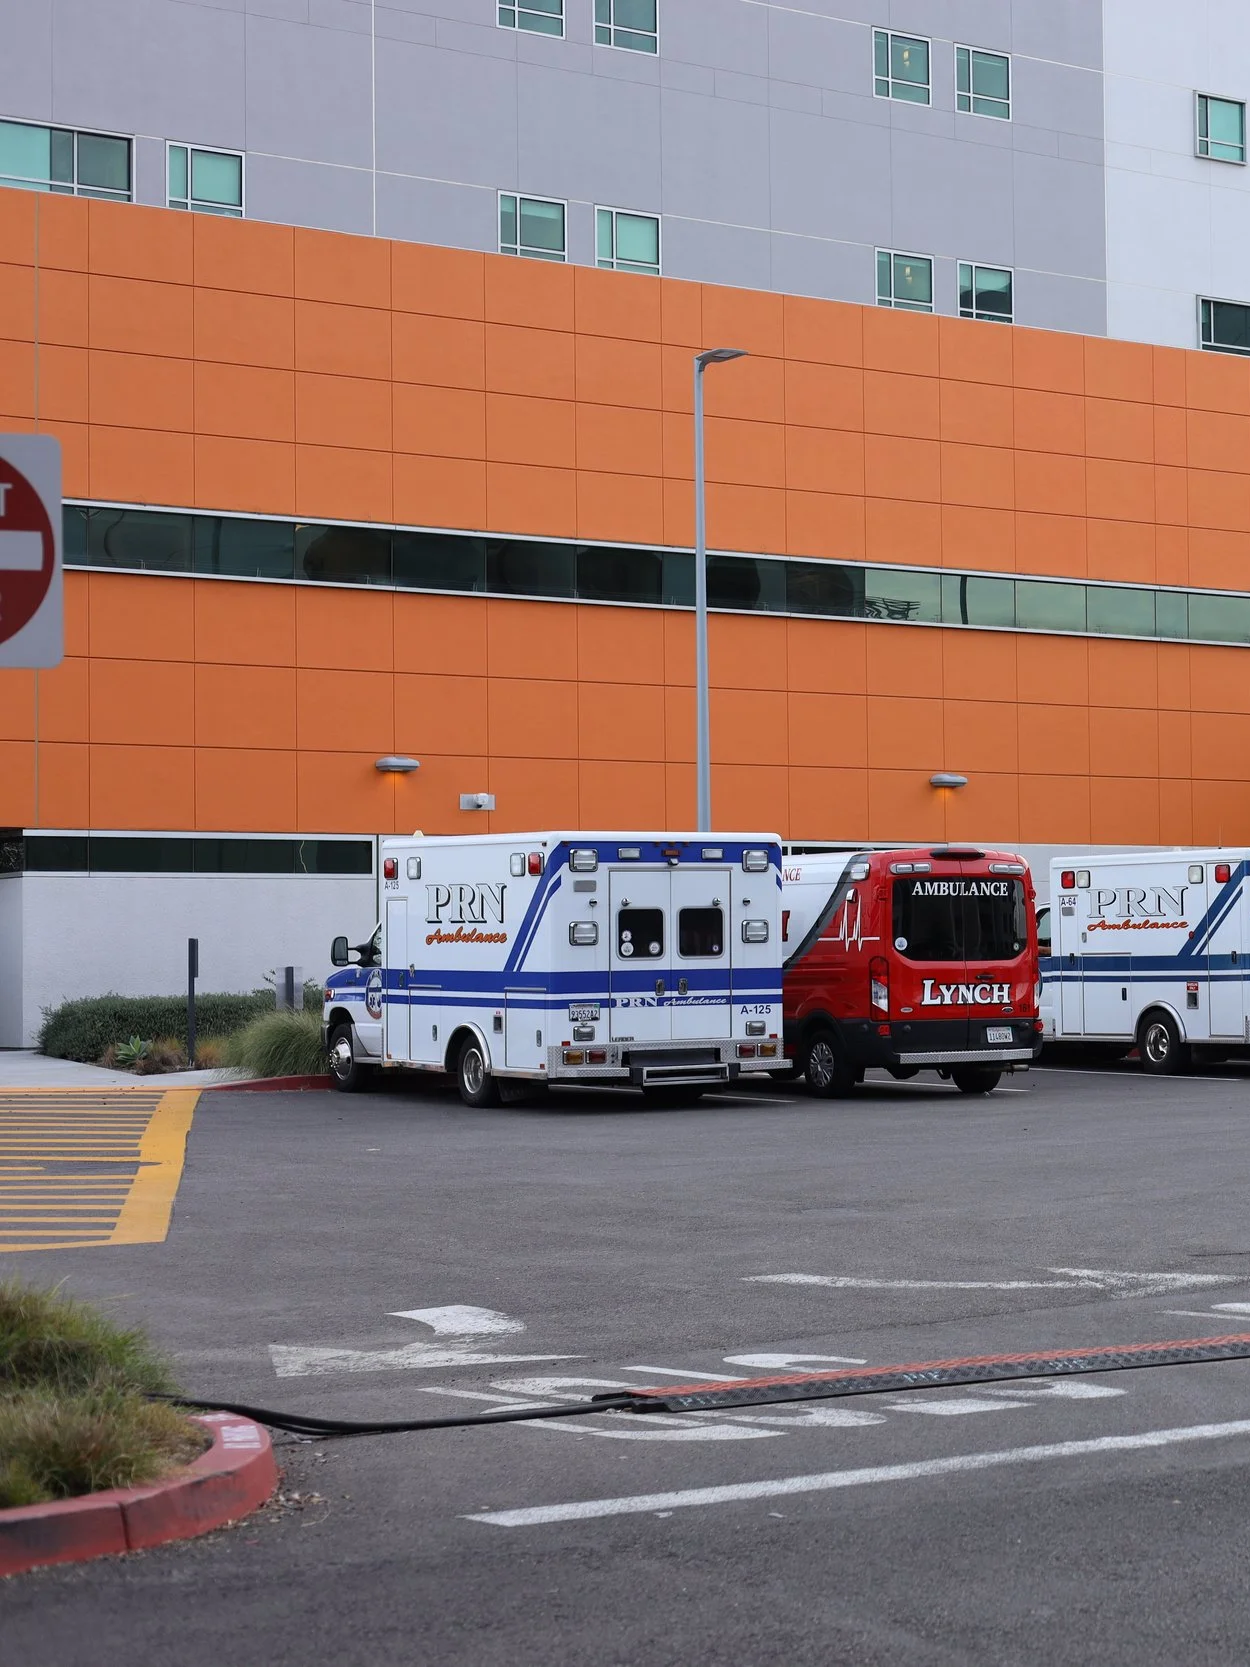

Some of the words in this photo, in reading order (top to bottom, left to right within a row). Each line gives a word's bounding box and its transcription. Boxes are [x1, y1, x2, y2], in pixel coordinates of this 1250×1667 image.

[384, 881, 399, 890] A-125
[912, 881, 1008, 896] AMBULANCE
[425, 883, 507, 923] PRN
[1061, 897, 1077, 906] A-64
[1086, 886, 1188, 918] PRN
[1087, 919, 1189, 931] Ambulance
[425, 926, 507, 945] Ambulance
[921, 979, 1011, 1006] LYNCH
[615, 997, 658, 1008] PRN
[664, 997, 727, 1007] Ambulance
[740, 1005, 771, 1015] A-125
